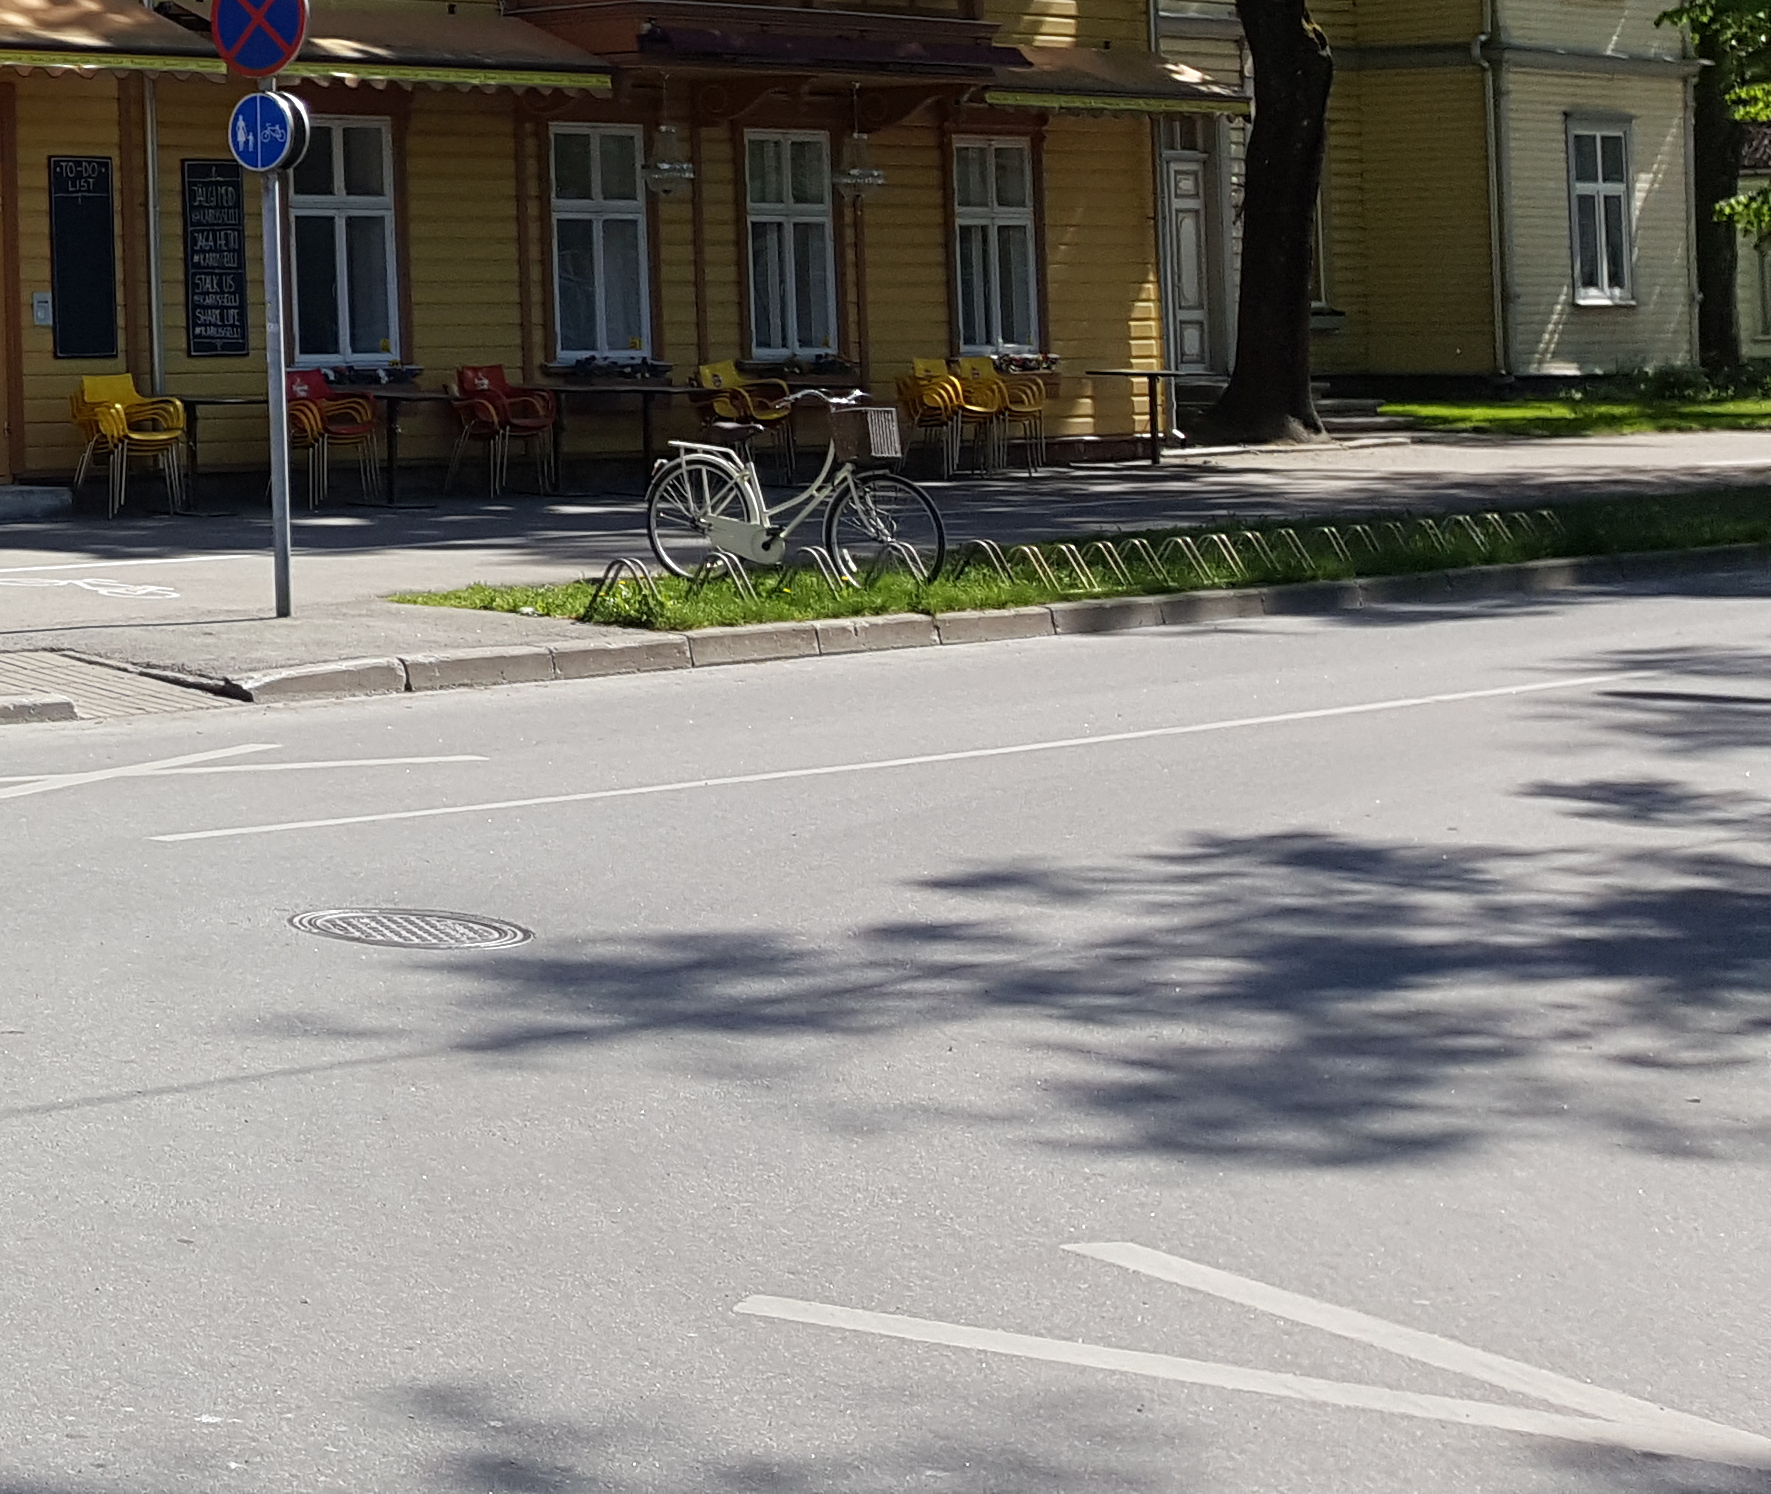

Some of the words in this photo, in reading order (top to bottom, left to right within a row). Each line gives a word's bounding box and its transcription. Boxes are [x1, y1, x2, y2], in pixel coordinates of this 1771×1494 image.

[60, 161, 98, 177] TO-DO
[68, 178, 94, 191] LIST
[195, 275, 219, 293] STALK
[222, 275, 235, 292] US
[195, 308, 221, 325] SHARE
